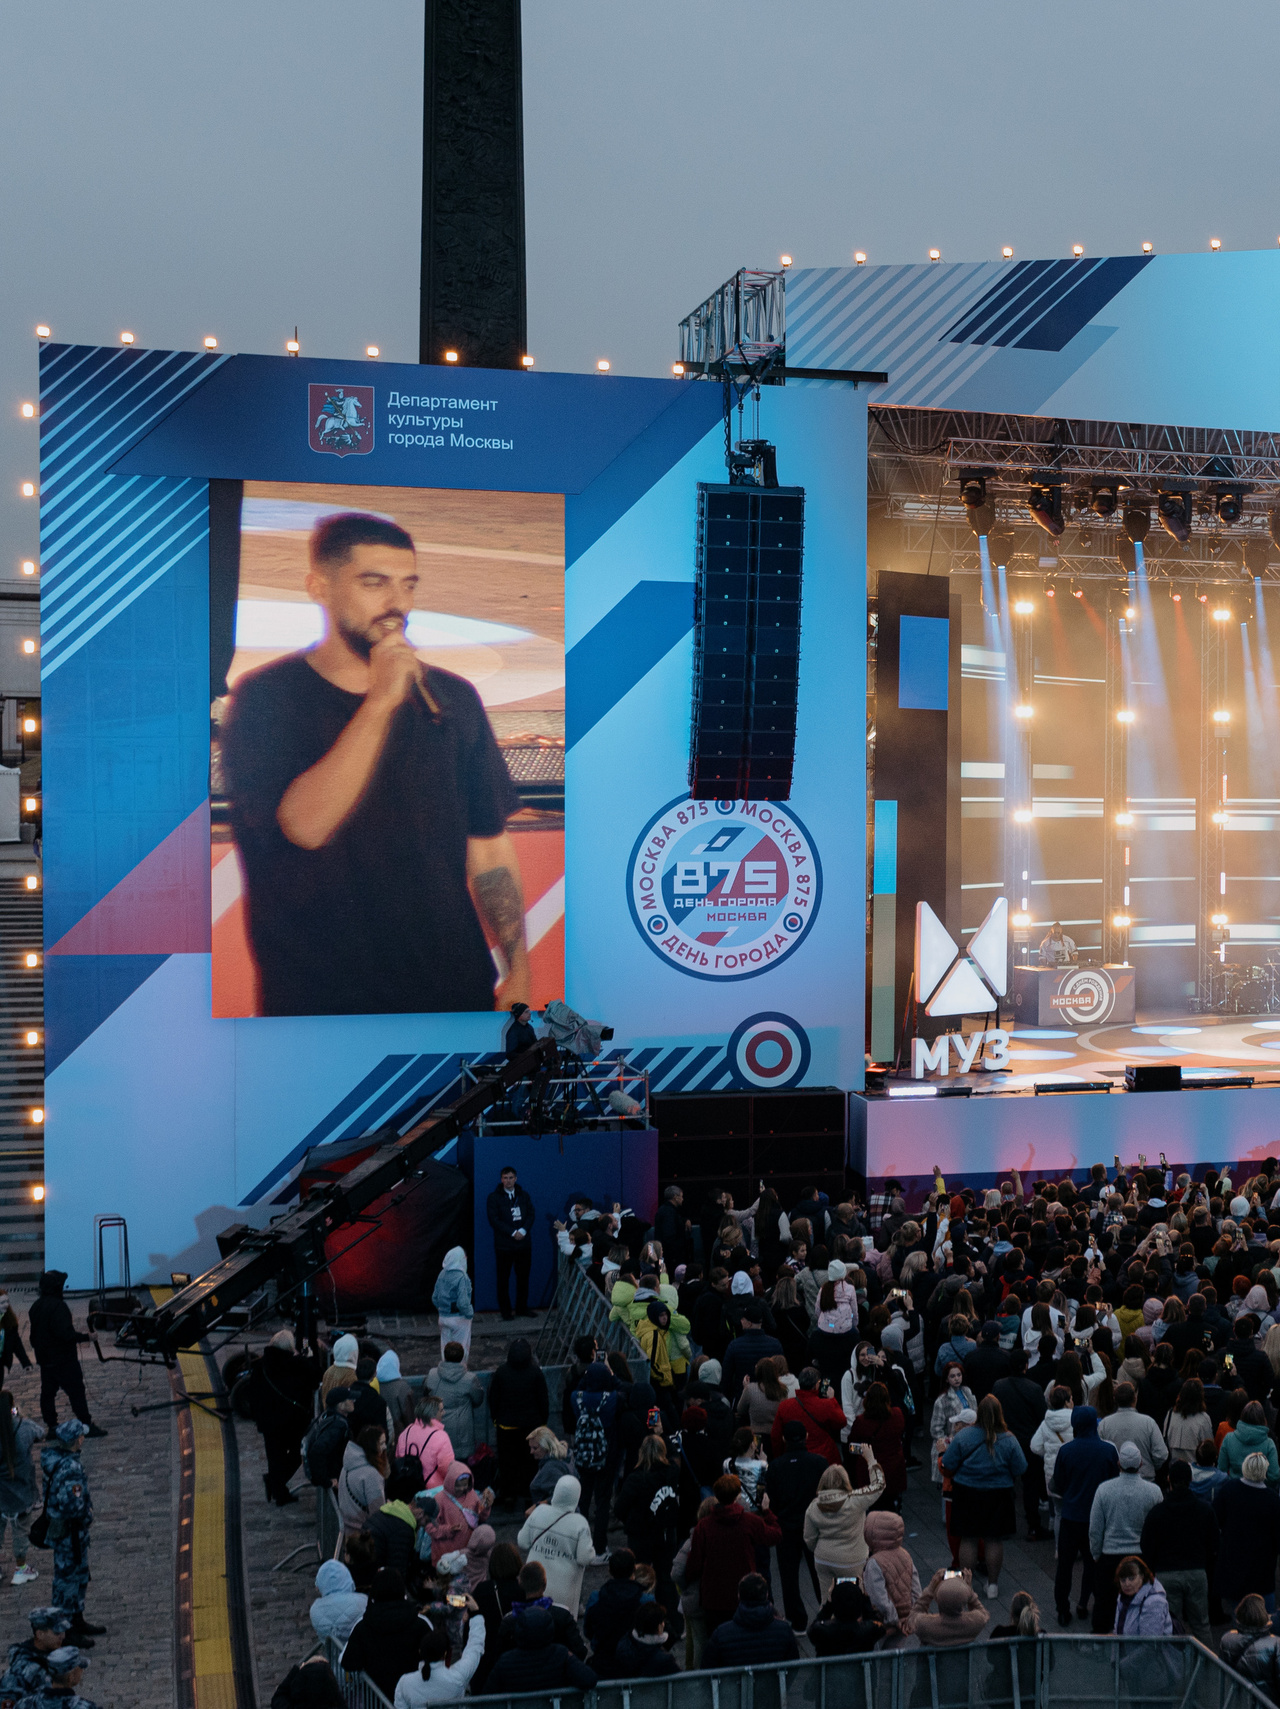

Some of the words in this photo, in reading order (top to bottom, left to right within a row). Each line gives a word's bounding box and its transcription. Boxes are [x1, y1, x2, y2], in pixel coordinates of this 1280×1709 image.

[387, 391, 499, 411] Департамент
[388, 413, 464, 431] культуры
[388, 432, 445, 449] города
[450, 433, 514, 450] Москвы
[638, 824, 677, 910] МОСКВА
[676, 802, 709, 825] 875
[740, 800, 807, 868] МОСКВА
[793, 874, 811, 908] 875
[673, 861, 777, 894] 875
[673, 898, 714, 909] ДЕНЬ
[718, 897, 777, 908] ГОРОДА
[706, 912, 767, 922] МОСКВА
[661, 934, 709, 967] ДЕНЬ
[715, 933, 789, 969] ГОРОДА
[1052, 996, 1092, 1006] МОСКВА
[911, 1029, 1010, 1079] МУЗ
